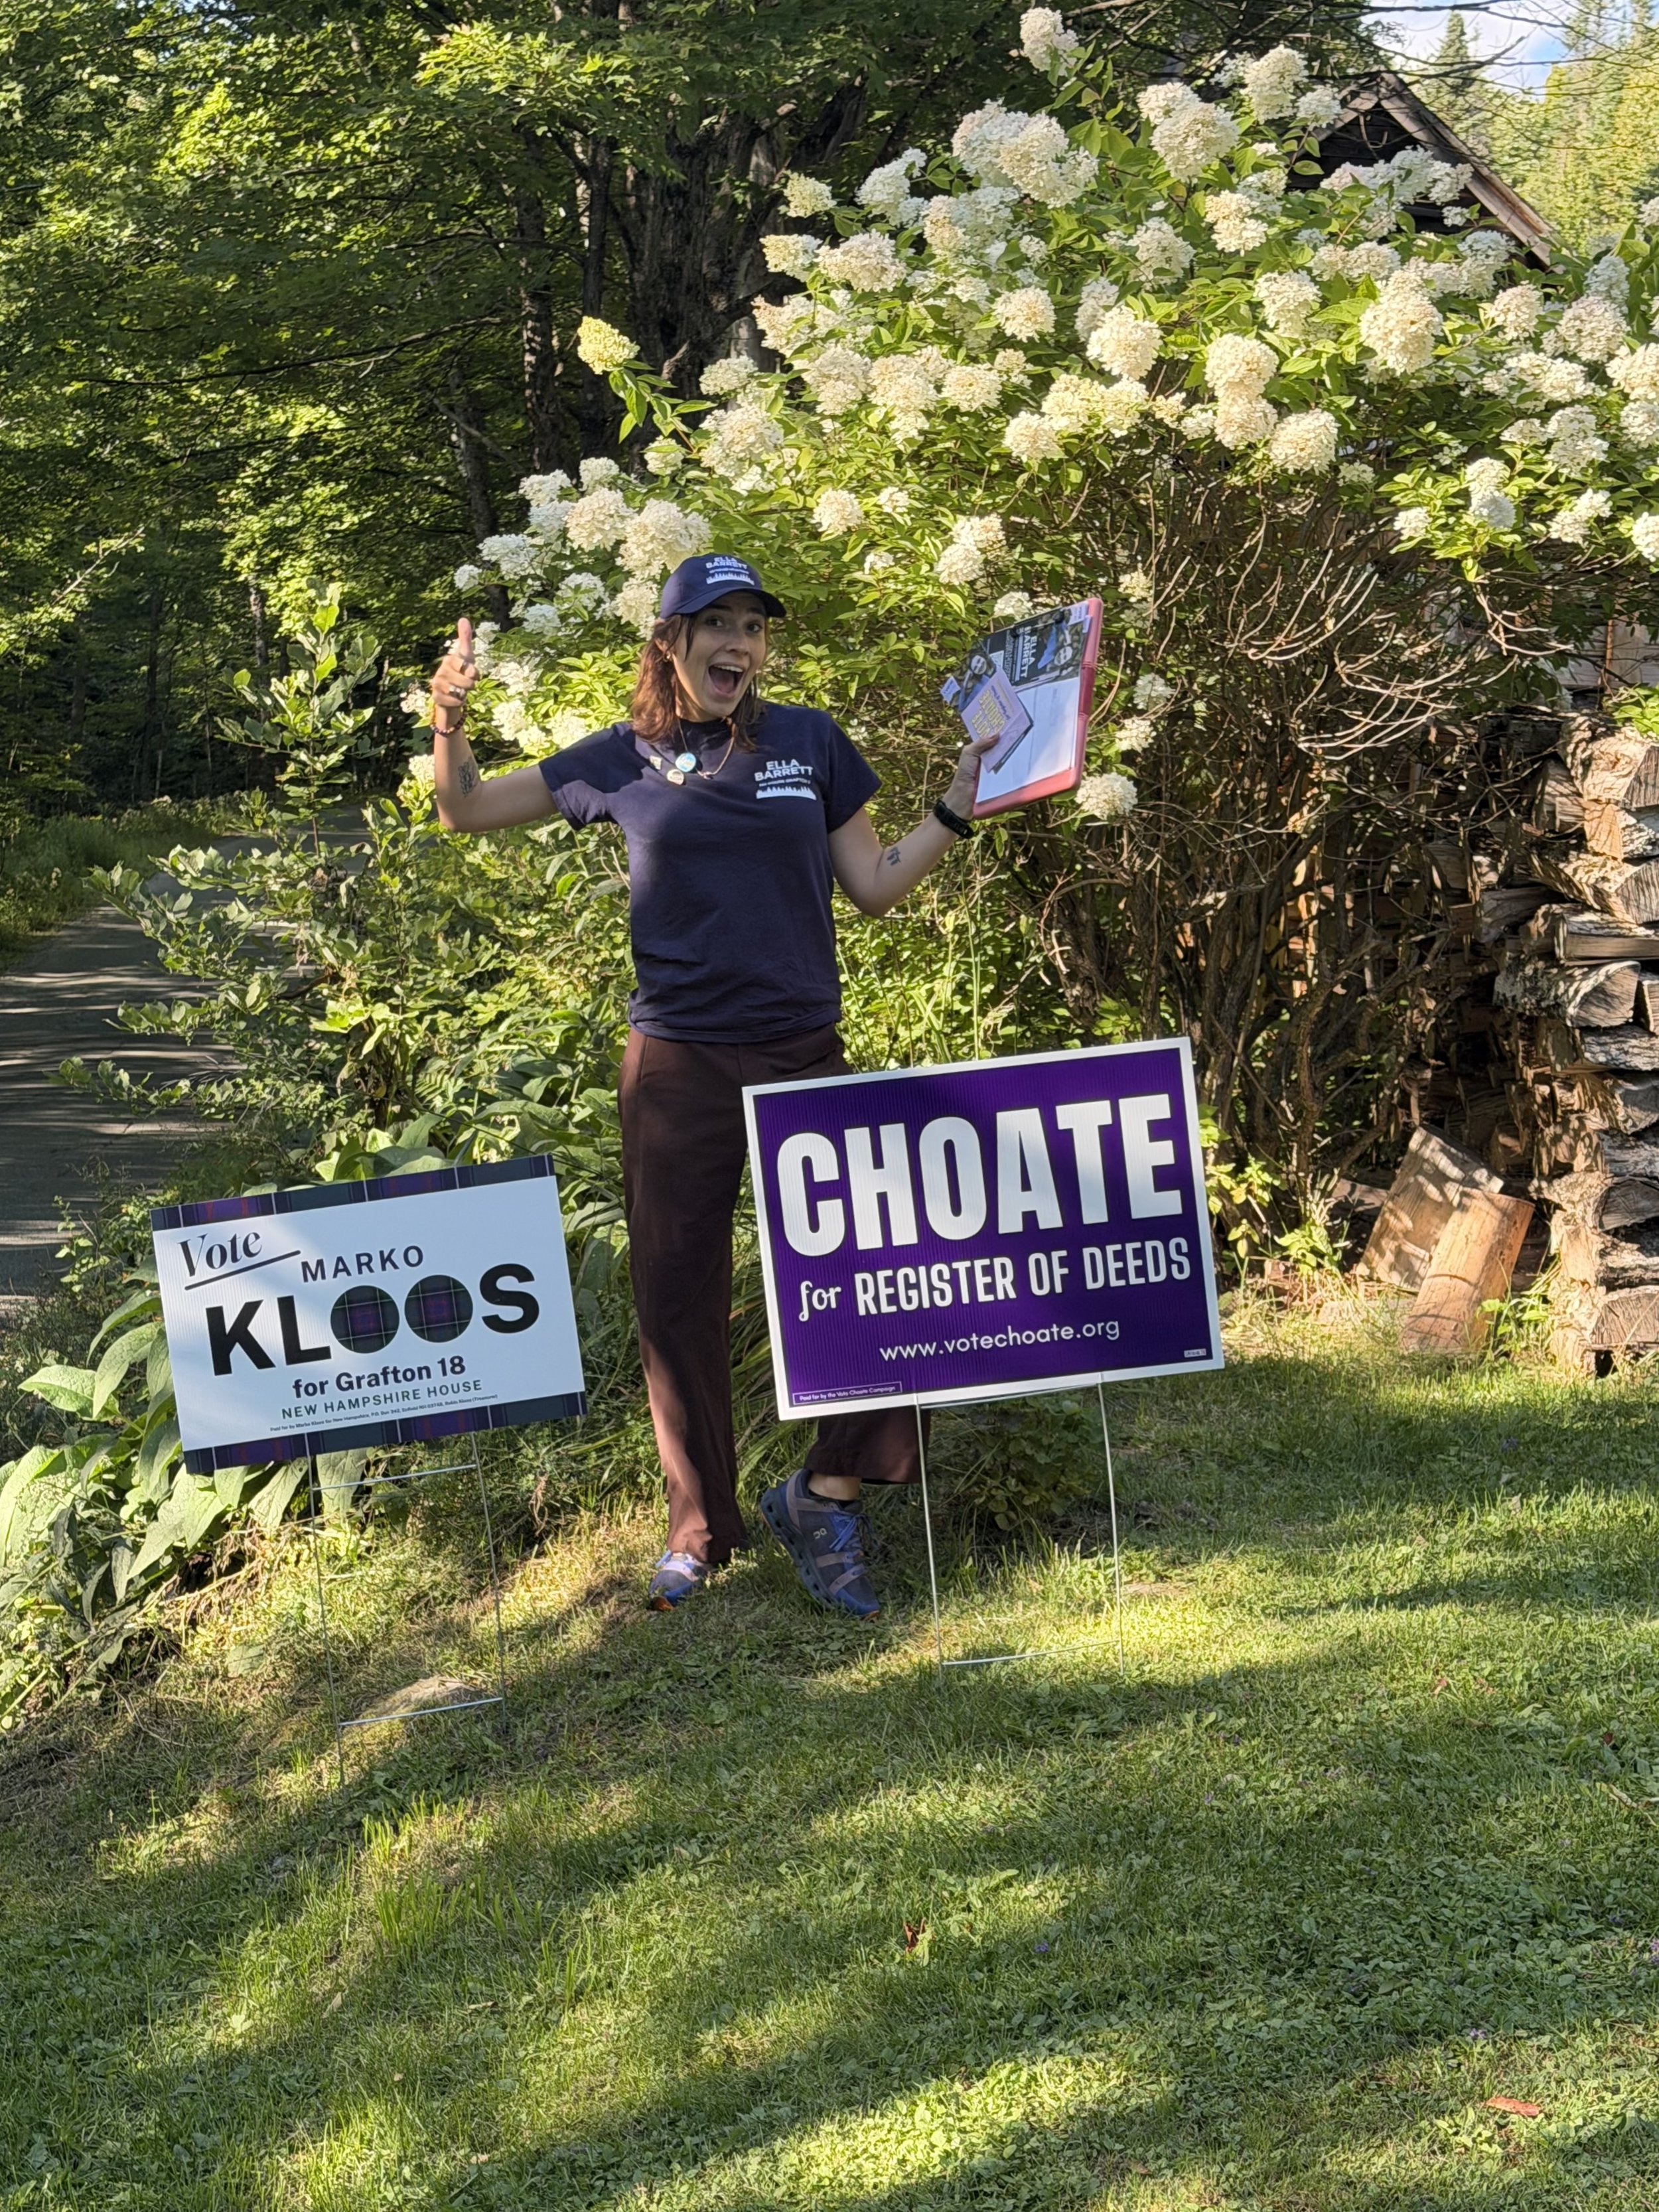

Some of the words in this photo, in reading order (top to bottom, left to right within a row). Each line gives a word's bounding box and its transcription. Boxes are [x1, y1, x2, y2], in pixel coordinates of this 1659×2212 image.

[755, 766, 814, 781] BARRETT
[766, 759, 800, 771] ELLA
[776, 1093, 1183, 1256] CHOATE
[178, 1231, 263, 1277] Vote
[301, 1245, 424, 1283] MARKO
[798, 1280, 841, 1321] for
[855, 1256, 1017, 1316] REGISTER
[1028, 1250, 1069, 1296] OF
[1083, 1236, 1190, 1290] DEEDS
[205, 1262, 540, 1377] KLOOS
[879, 1318, 1120, 1362] www.votechoate.org
[292, 1378, 328, 1398] for
[335, 1363, 433, 1392] Grafton
[437, 1355, 466, 1378] 18
[281, 1404, 317, 1420] NEW
[324, 1388, 421, 1414] HAMPSHIRE
[427, 1379, 482, 1398] HOUSE
